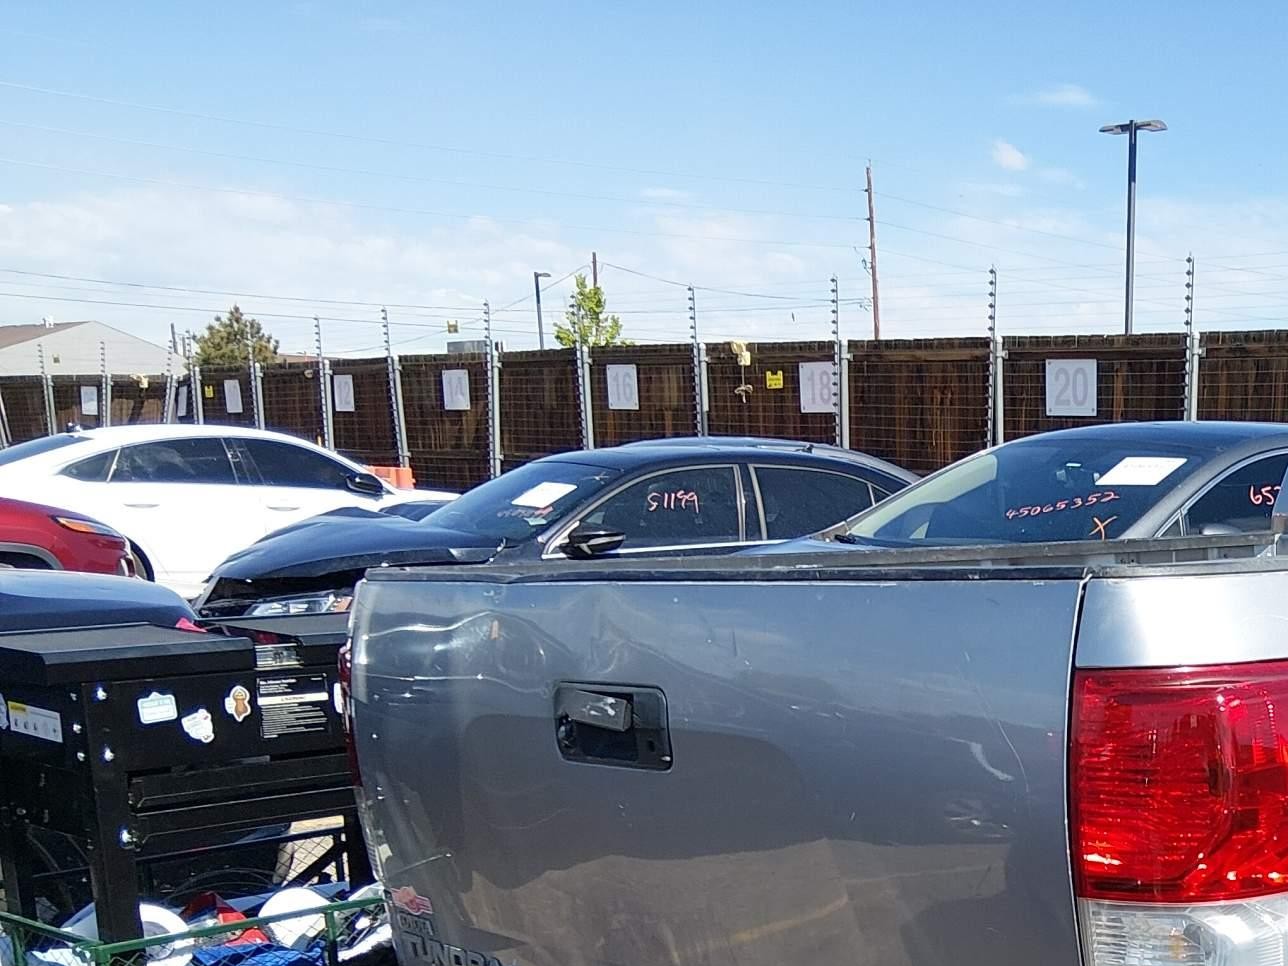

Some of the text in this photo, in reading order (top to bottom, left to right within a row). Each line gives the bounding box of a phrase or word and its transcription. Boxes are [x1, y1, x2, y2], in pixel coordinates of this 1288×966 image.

[611, 371, 634, 404] 16
[808, 370, 832, 404] 18
[1055, 367, 1089, 407] 20
[1006, 491, 1120, 520] 45065352
